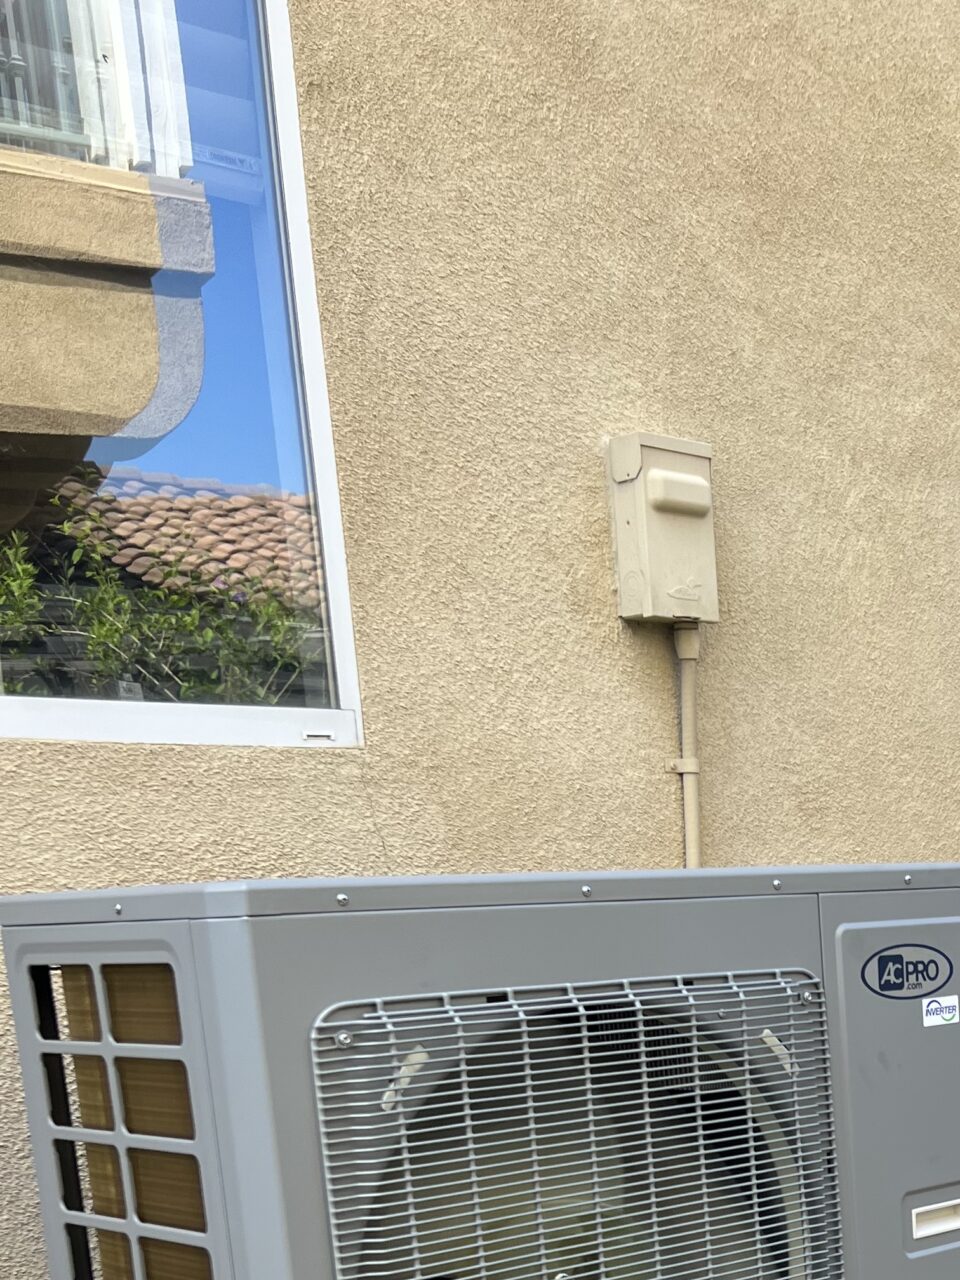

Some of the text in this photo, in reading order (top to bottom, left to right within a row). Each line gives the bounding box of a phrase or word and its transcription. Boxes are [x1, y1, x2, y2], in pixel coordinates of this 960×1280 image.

[881, 959, 939, 985] AC PRO
[906, 982, 923, 990] .com
[925, 1005, 957, 1017] INVERTER
